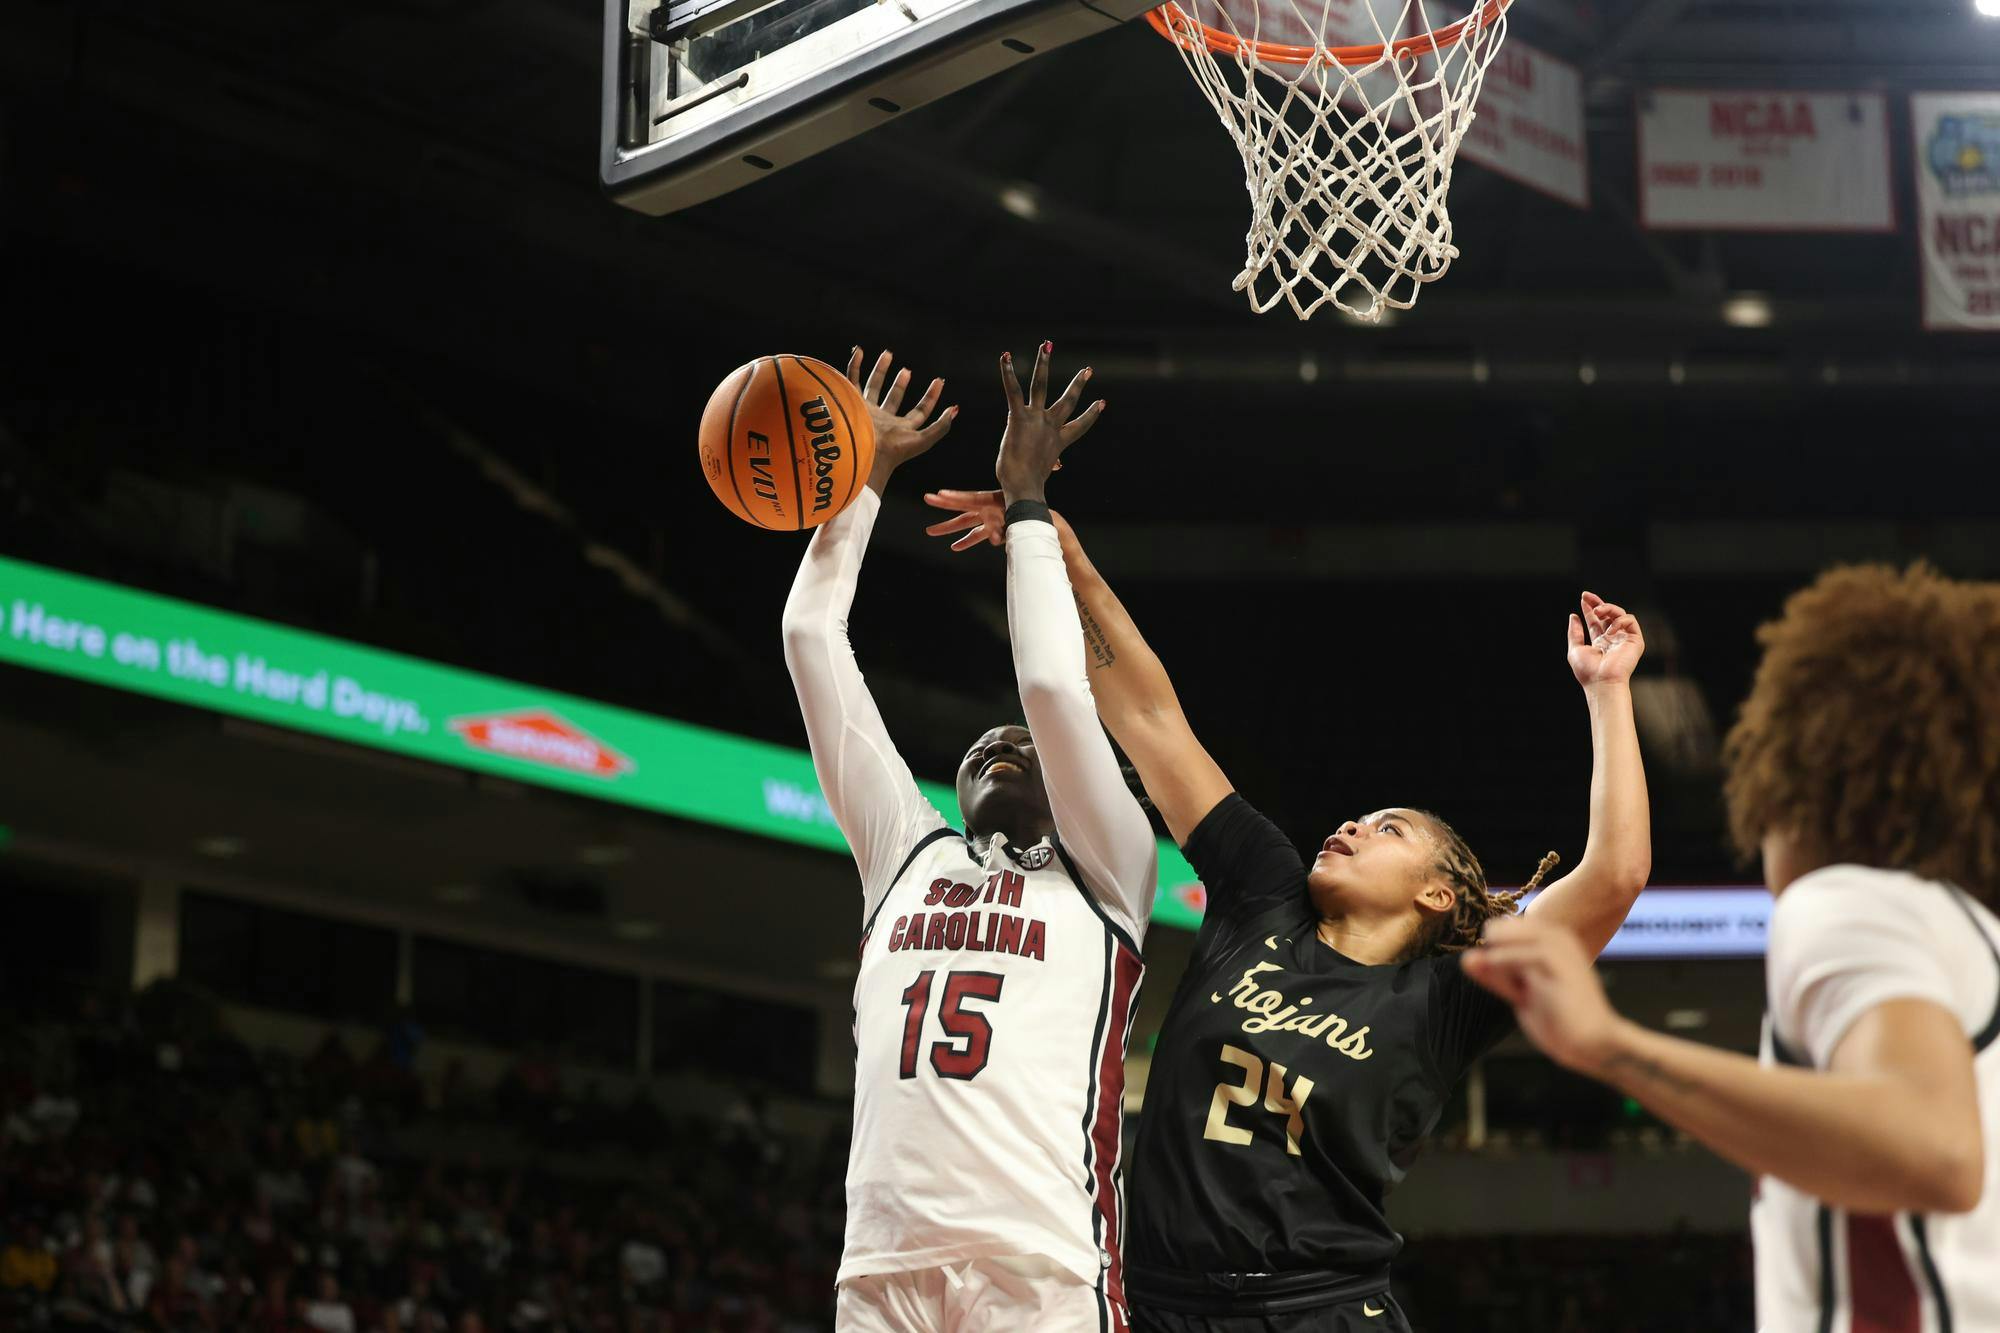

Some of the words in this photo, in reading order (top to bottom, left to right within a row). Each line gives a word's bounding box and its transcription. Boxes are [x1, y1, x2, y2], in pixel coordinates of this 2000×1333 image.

[1710, 102, 1817, 139] NCAA
[800, 395, 841, 513] Wilson
[11, 601, 106, 657] Here
[112, 632, 161, 671] on
[167, 639, 230, 687] the
[234, 652, 329, 710] Hard
[332, 677, 430, 734] Days.
[888, 911, 1046, 961] CAROLINA
[900, 970, 1005, 1081] 15
[1203, 1044, 1315, 1156] 24
